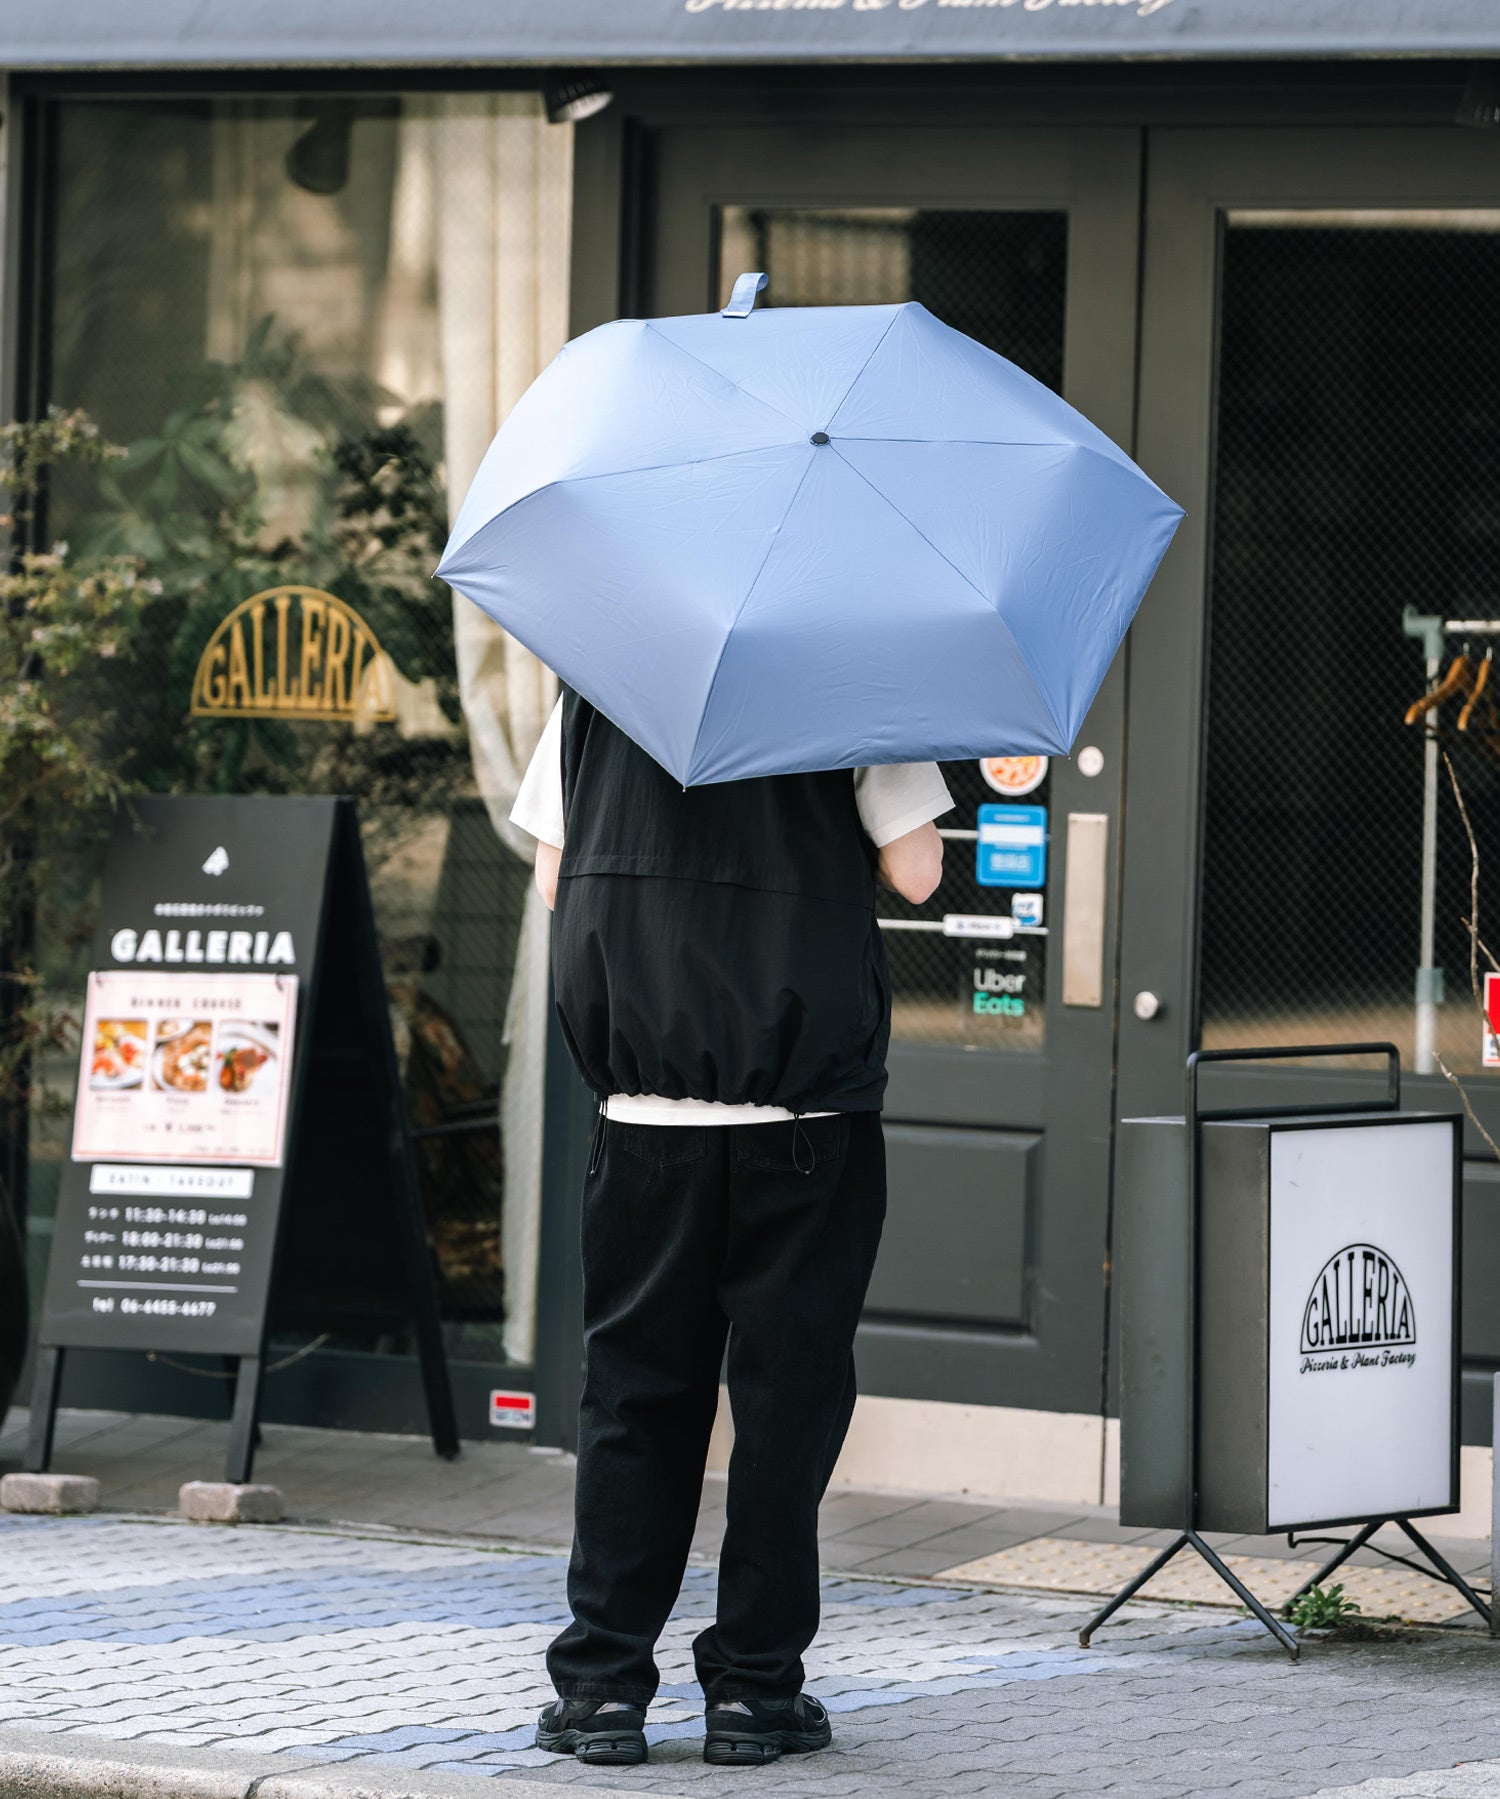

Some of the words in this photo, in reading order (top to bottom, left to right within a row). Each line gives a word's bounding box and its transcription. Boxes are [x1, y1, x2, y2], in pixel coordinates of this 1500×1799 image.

[203, 596, 394, 709] GALLERIA
[111, 928, 296, 965] GALLERIA
[973, 968, 1026, 992] Uber
[973, 991, 1025, 1017] Eats
[1306, 1250, 1411, 1347] GALLERIA
[1300, 1356, 1338, 1374] Pizzeria
[1340, 1355, 1349, 1370] &
[1351, 1352, 1380, 1369] Plant
[1381, 1350, 1416, 1368] Factory
